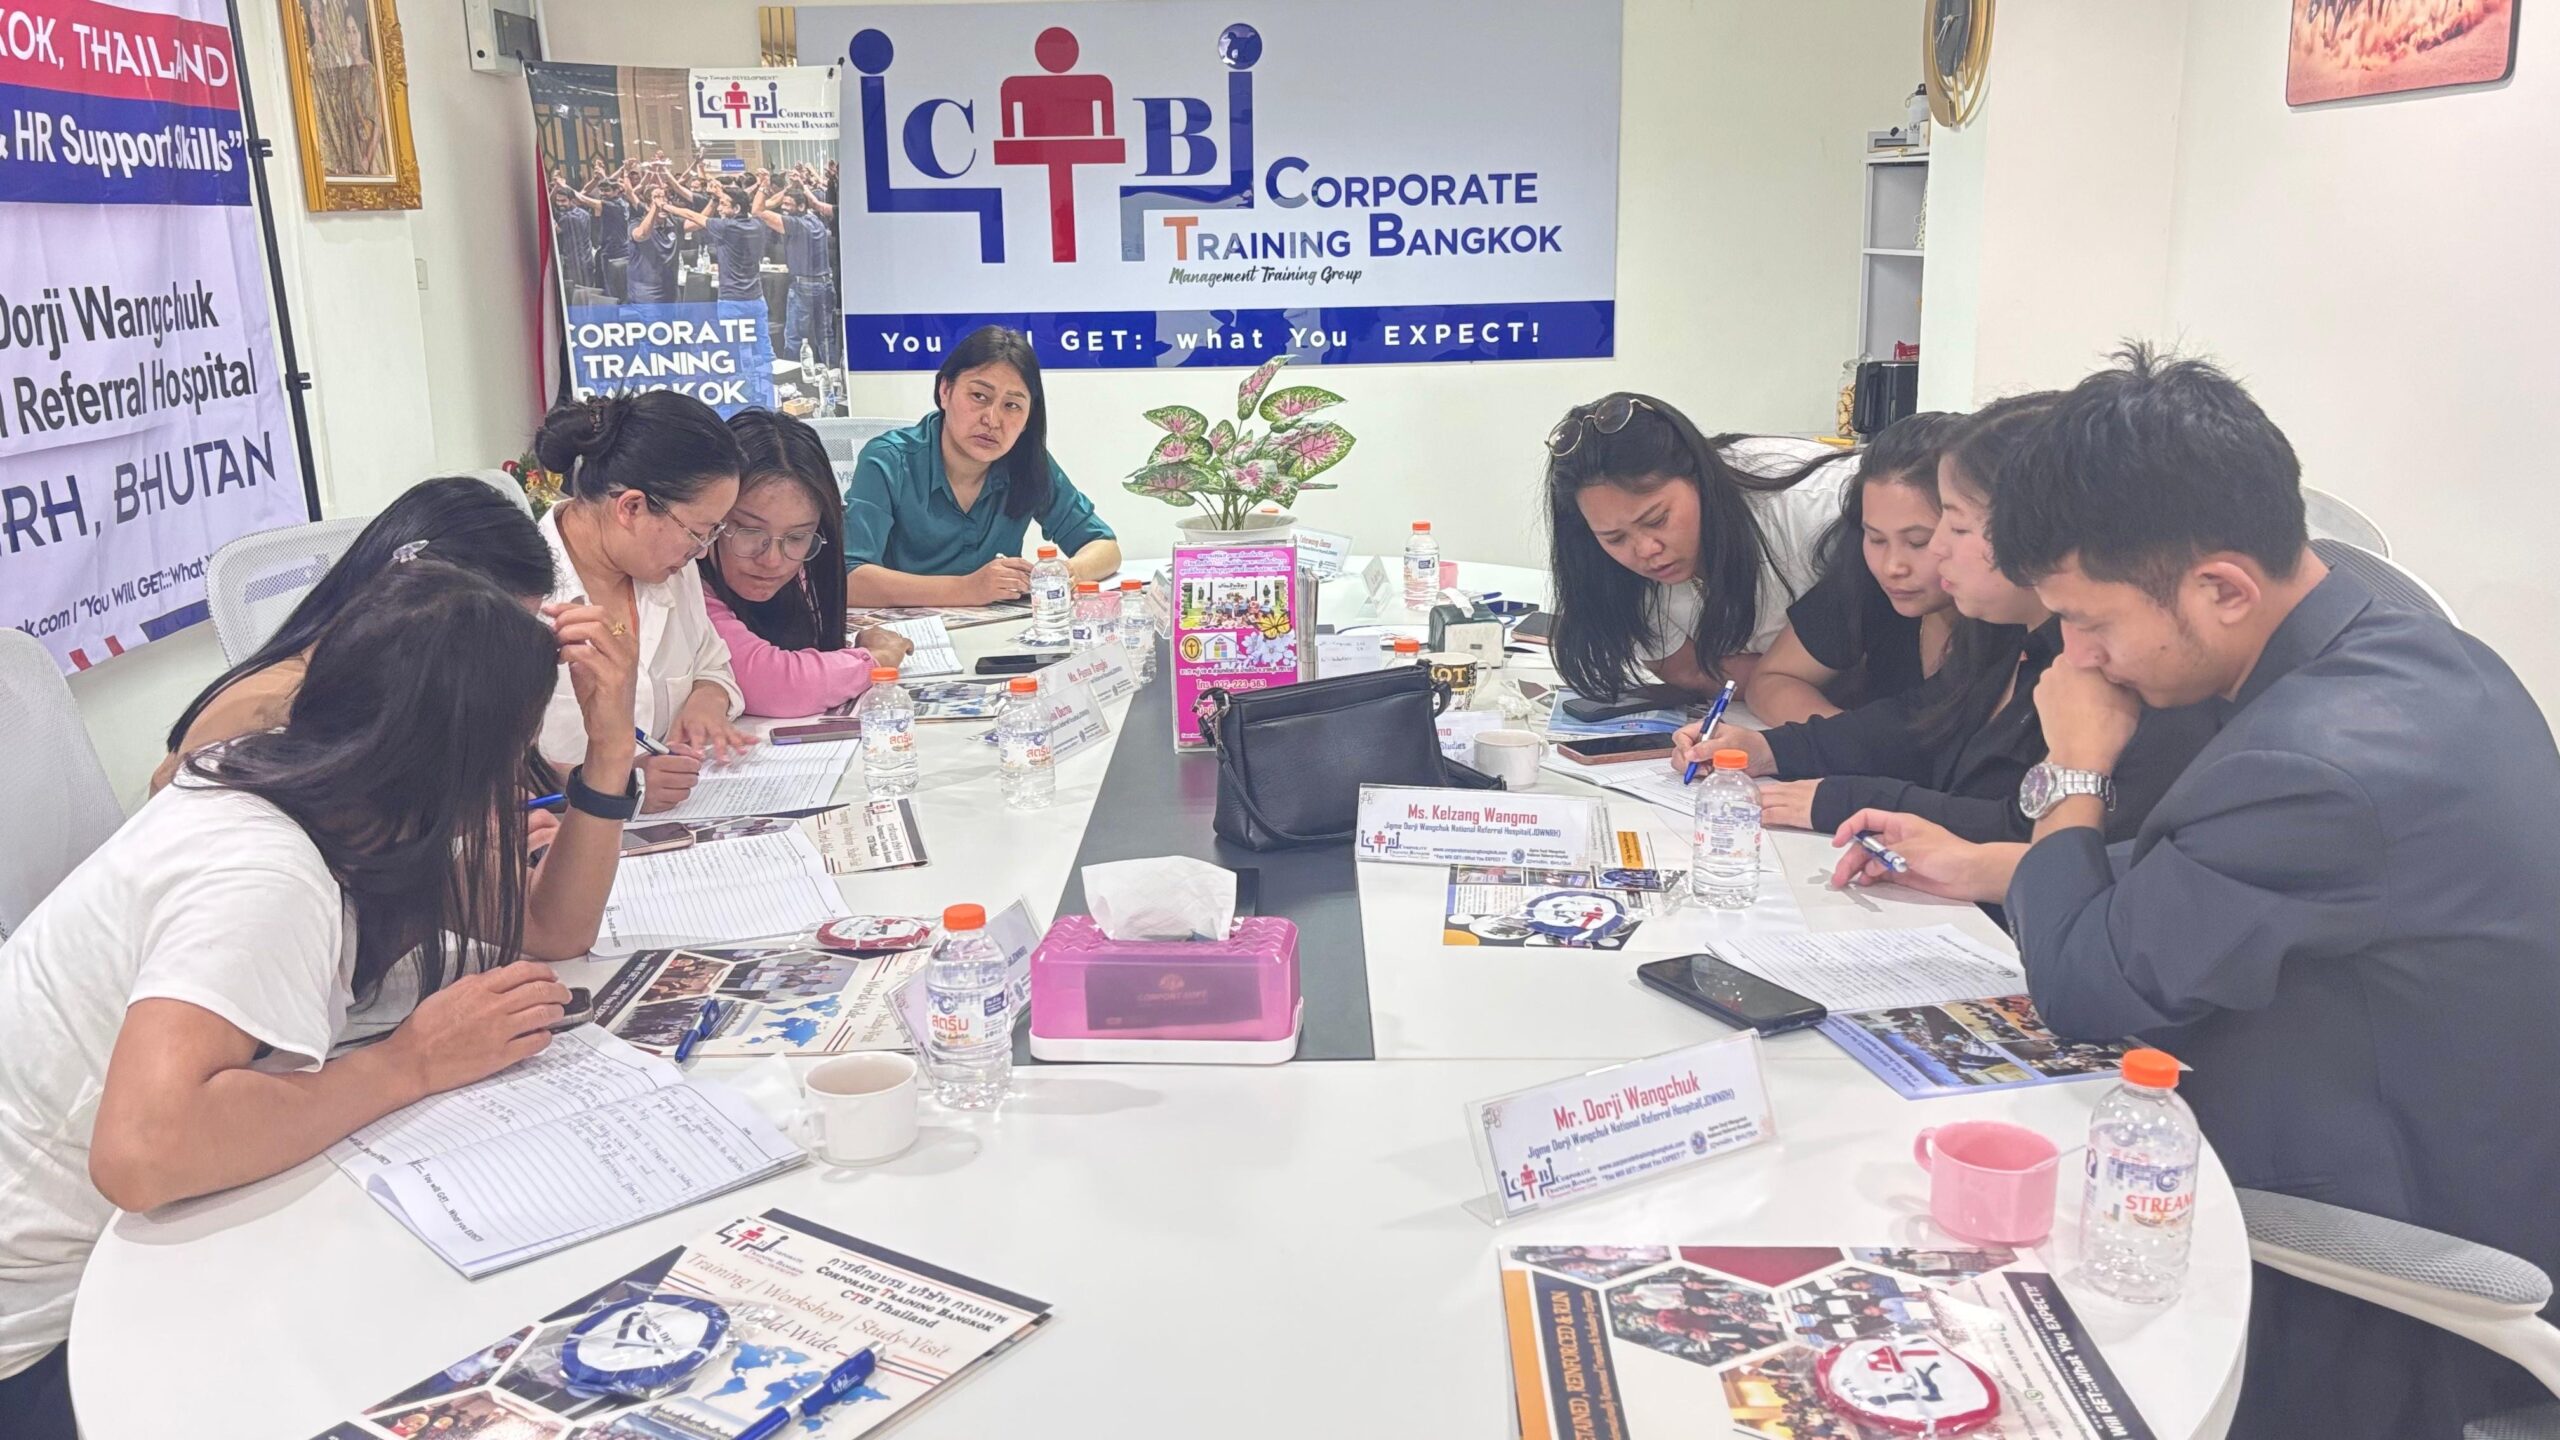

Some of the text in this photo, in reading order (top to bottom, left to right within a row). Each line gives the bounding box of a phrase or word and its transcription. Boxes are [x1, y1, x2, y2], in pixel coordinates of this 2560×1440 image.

[73, 23, 229, 87] THAILAND
[14, 110, 56, 163] HR
[60, 115, 173, 178] Support
[1265, 156, 1538, 209] CORPORATE
[1163, 212, 1562, 262] TRAINING BANGKOK
[1168, 265, 1362, 288] Management Training Group
[68, 280, 219, 348] Wangchuk
[881, 332, 942, 353] You
[1061, 330, 1143, 352] GET:
[1176, 328, 1264, 350] what
[1289, 327, 1347, 348] You
[1384, 322, 1540, 346] EXPECT!
[582, 350, 736, 379] TRAINING
[13, 370, 147, 435] Referral
[152, 347, 258, 415] Hospital
[0, 431, 276, 554] RH, BHUTAN
[112, 580, 136, 603] Will
[1440, 741, 1466, 751] Studies
[1408, 804, 1538, 827] Ms. Kelzang Wangmo
[1419, 823, 1450, 833] Wangchuk
[1451, 824, 1476, 834] National
[1477, 826, 1503, 835] Referral
[1553, 1070, 1701, 1131] Mr. Dorji Wangchuk
[1528, 1145, 1551, 1159] Jigme
[1551, 1138, 1572, 1152] Dorji
[1571, 1127, 1610, 1146] Wangchuk
[1610, 1119, 1641, 1135] National
[686, 1252, 751, 1290] Training
[762, 1283, 844, 1325] Workshop
[816, 1266, 995, 1333] CORPORATE TRAINING BANGKOK
[1551, 1290, 1572, 1314] RUN
[730, 1302, 839, 1353] World-Wide
[840, 1289, 940, 1329] CTB Thailand
[2053, 1330, 2074, 1357] You
